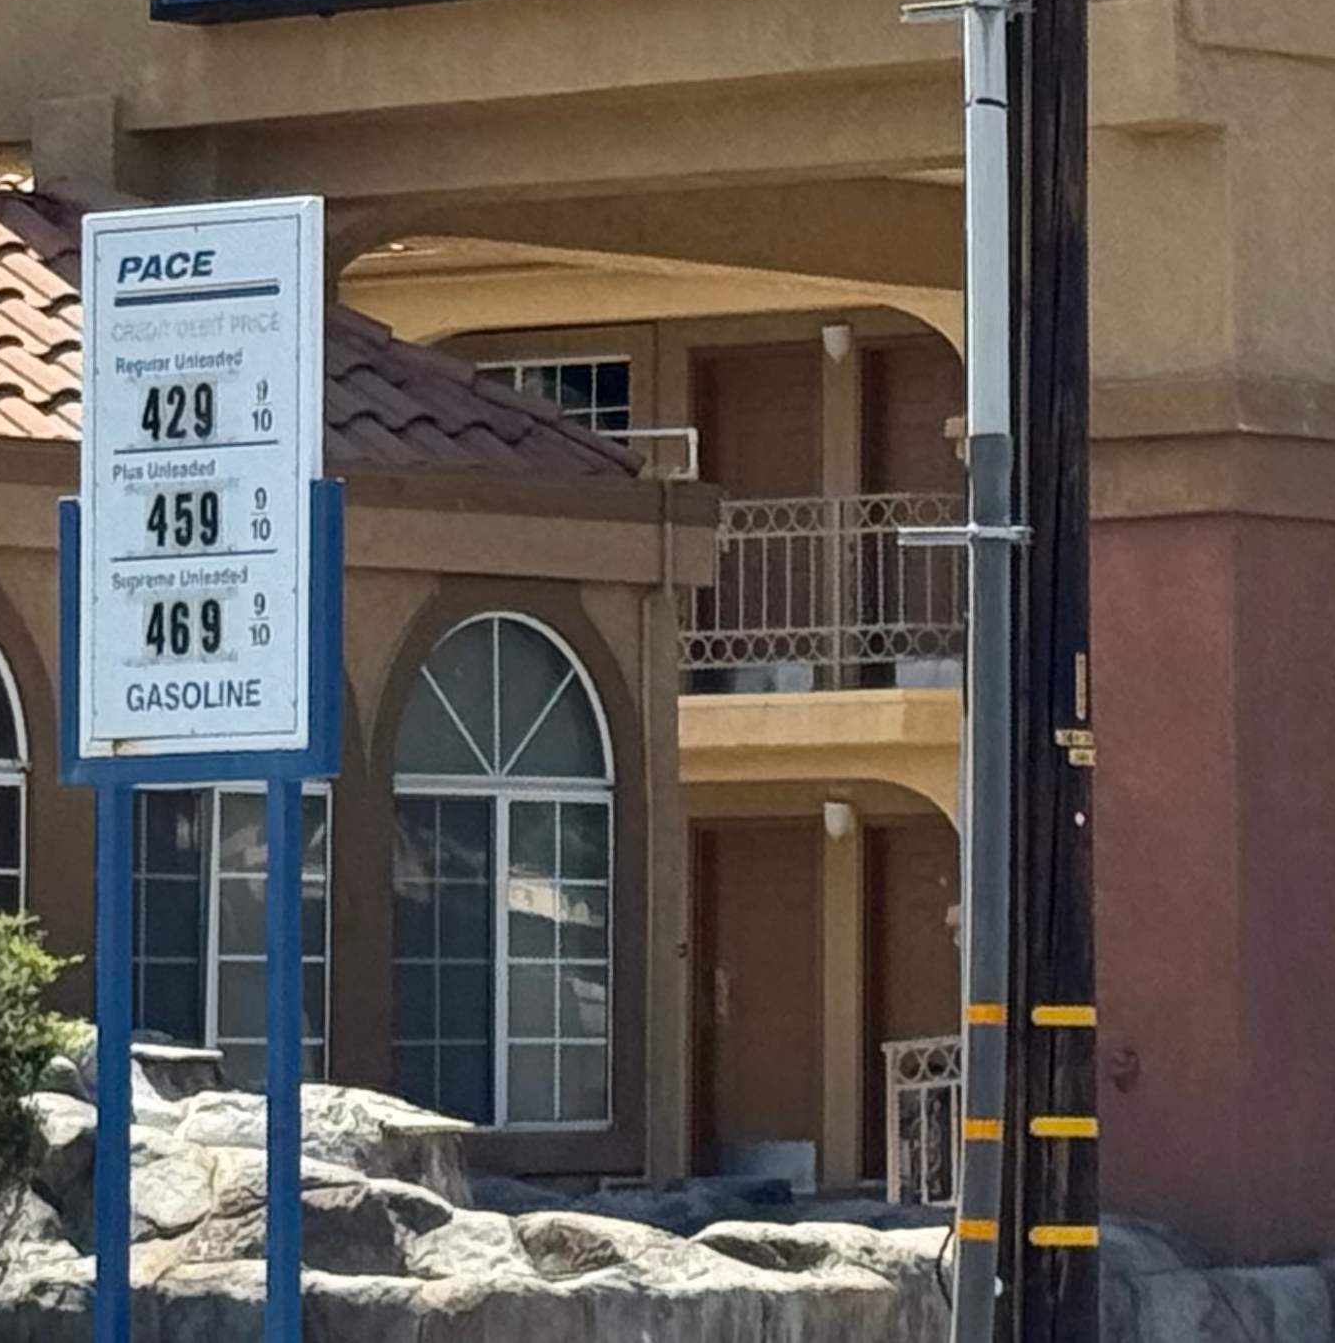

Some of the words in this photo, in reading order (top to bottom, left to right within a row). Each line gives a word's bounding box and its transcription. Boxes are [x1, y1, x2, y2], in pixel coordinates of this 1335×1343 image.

[117, 250, 216, 284] PACE
[230, 310, 281, 335] PRICE
[115, 355, 171, 377] Regular
[174, 346, 245, 370] Unleaded
[142, 382, 213, 441] 429
[113, 462, 144, 482] Plus
[147, 458, 216, 478] Unleaded
[147, 490, 219, 547] 459
[111, 571, 176, 595] Supreme
[180, 565, 249, 587] Unleaded
[146, 598, 221, 657] 469
[126, 678, 262, 712] GASOLINE
